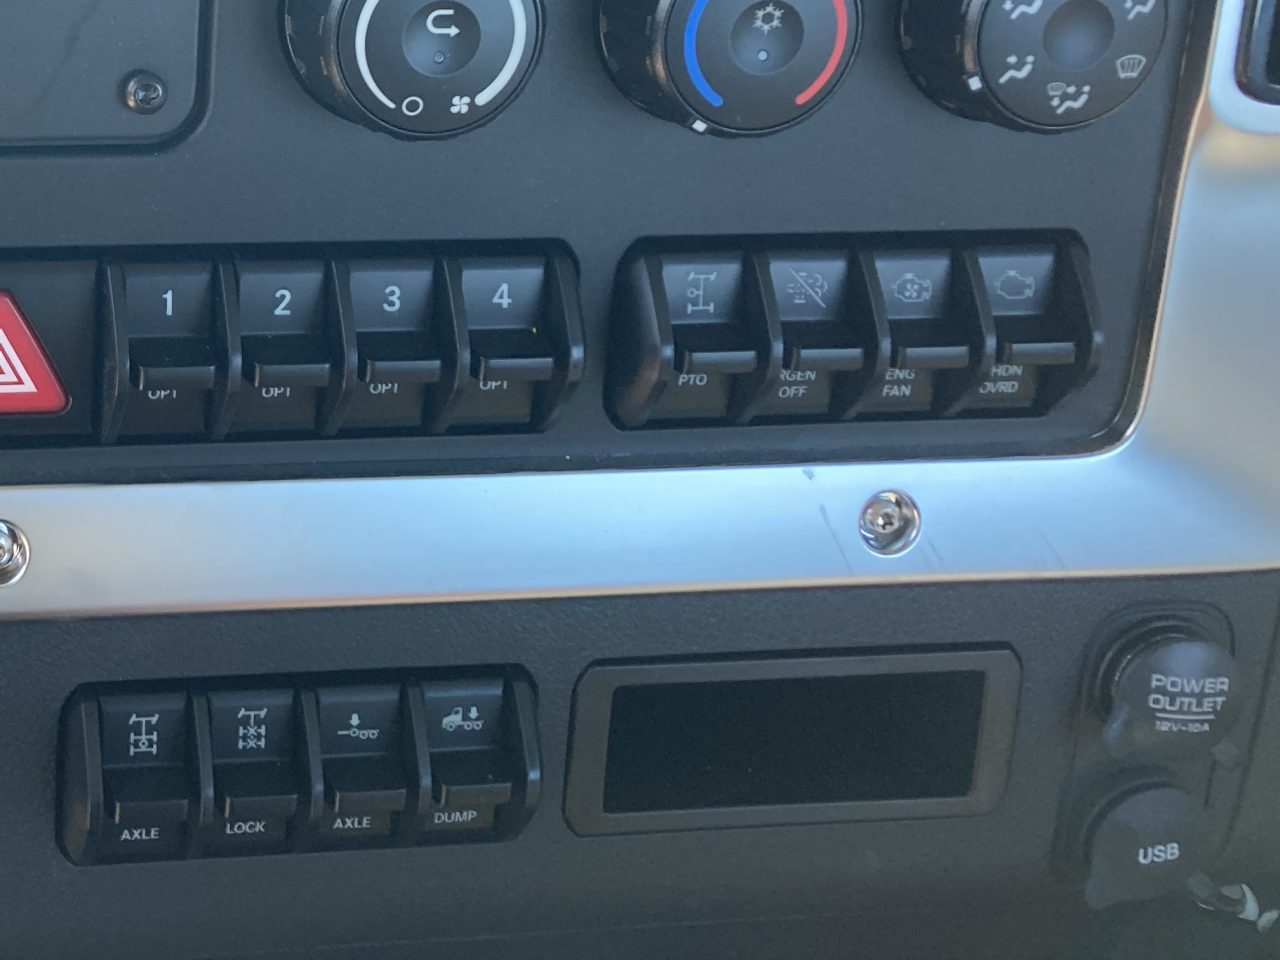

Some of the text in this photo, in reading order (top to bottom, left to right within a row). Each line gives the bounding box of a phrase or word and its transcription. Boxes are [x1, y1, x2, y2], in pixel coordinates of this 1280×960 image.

[160, 289, 174, 316] 1
[273, 288, 292, 316] 2
[382, 285, 402, 313] 3
[491, 282, 513, 309] 4
[677, 373, 708, 387] PTO
[884, 368, 917, 381] ENG
[778, 385, 809, 399] OFF
[882, 384, 913, 397] FAN
[1149, 672, 1230, 694] POWER
[1147, 693, 1228, 713] OUTLET
[332, 814, 373, 830] AXLE
[432, 808, 479, 825] DUMP
[120, 826, 161, 842] AXLE
[224, 820, 267, 835] LOCK
[1136, 842, 1181, 865] USB
